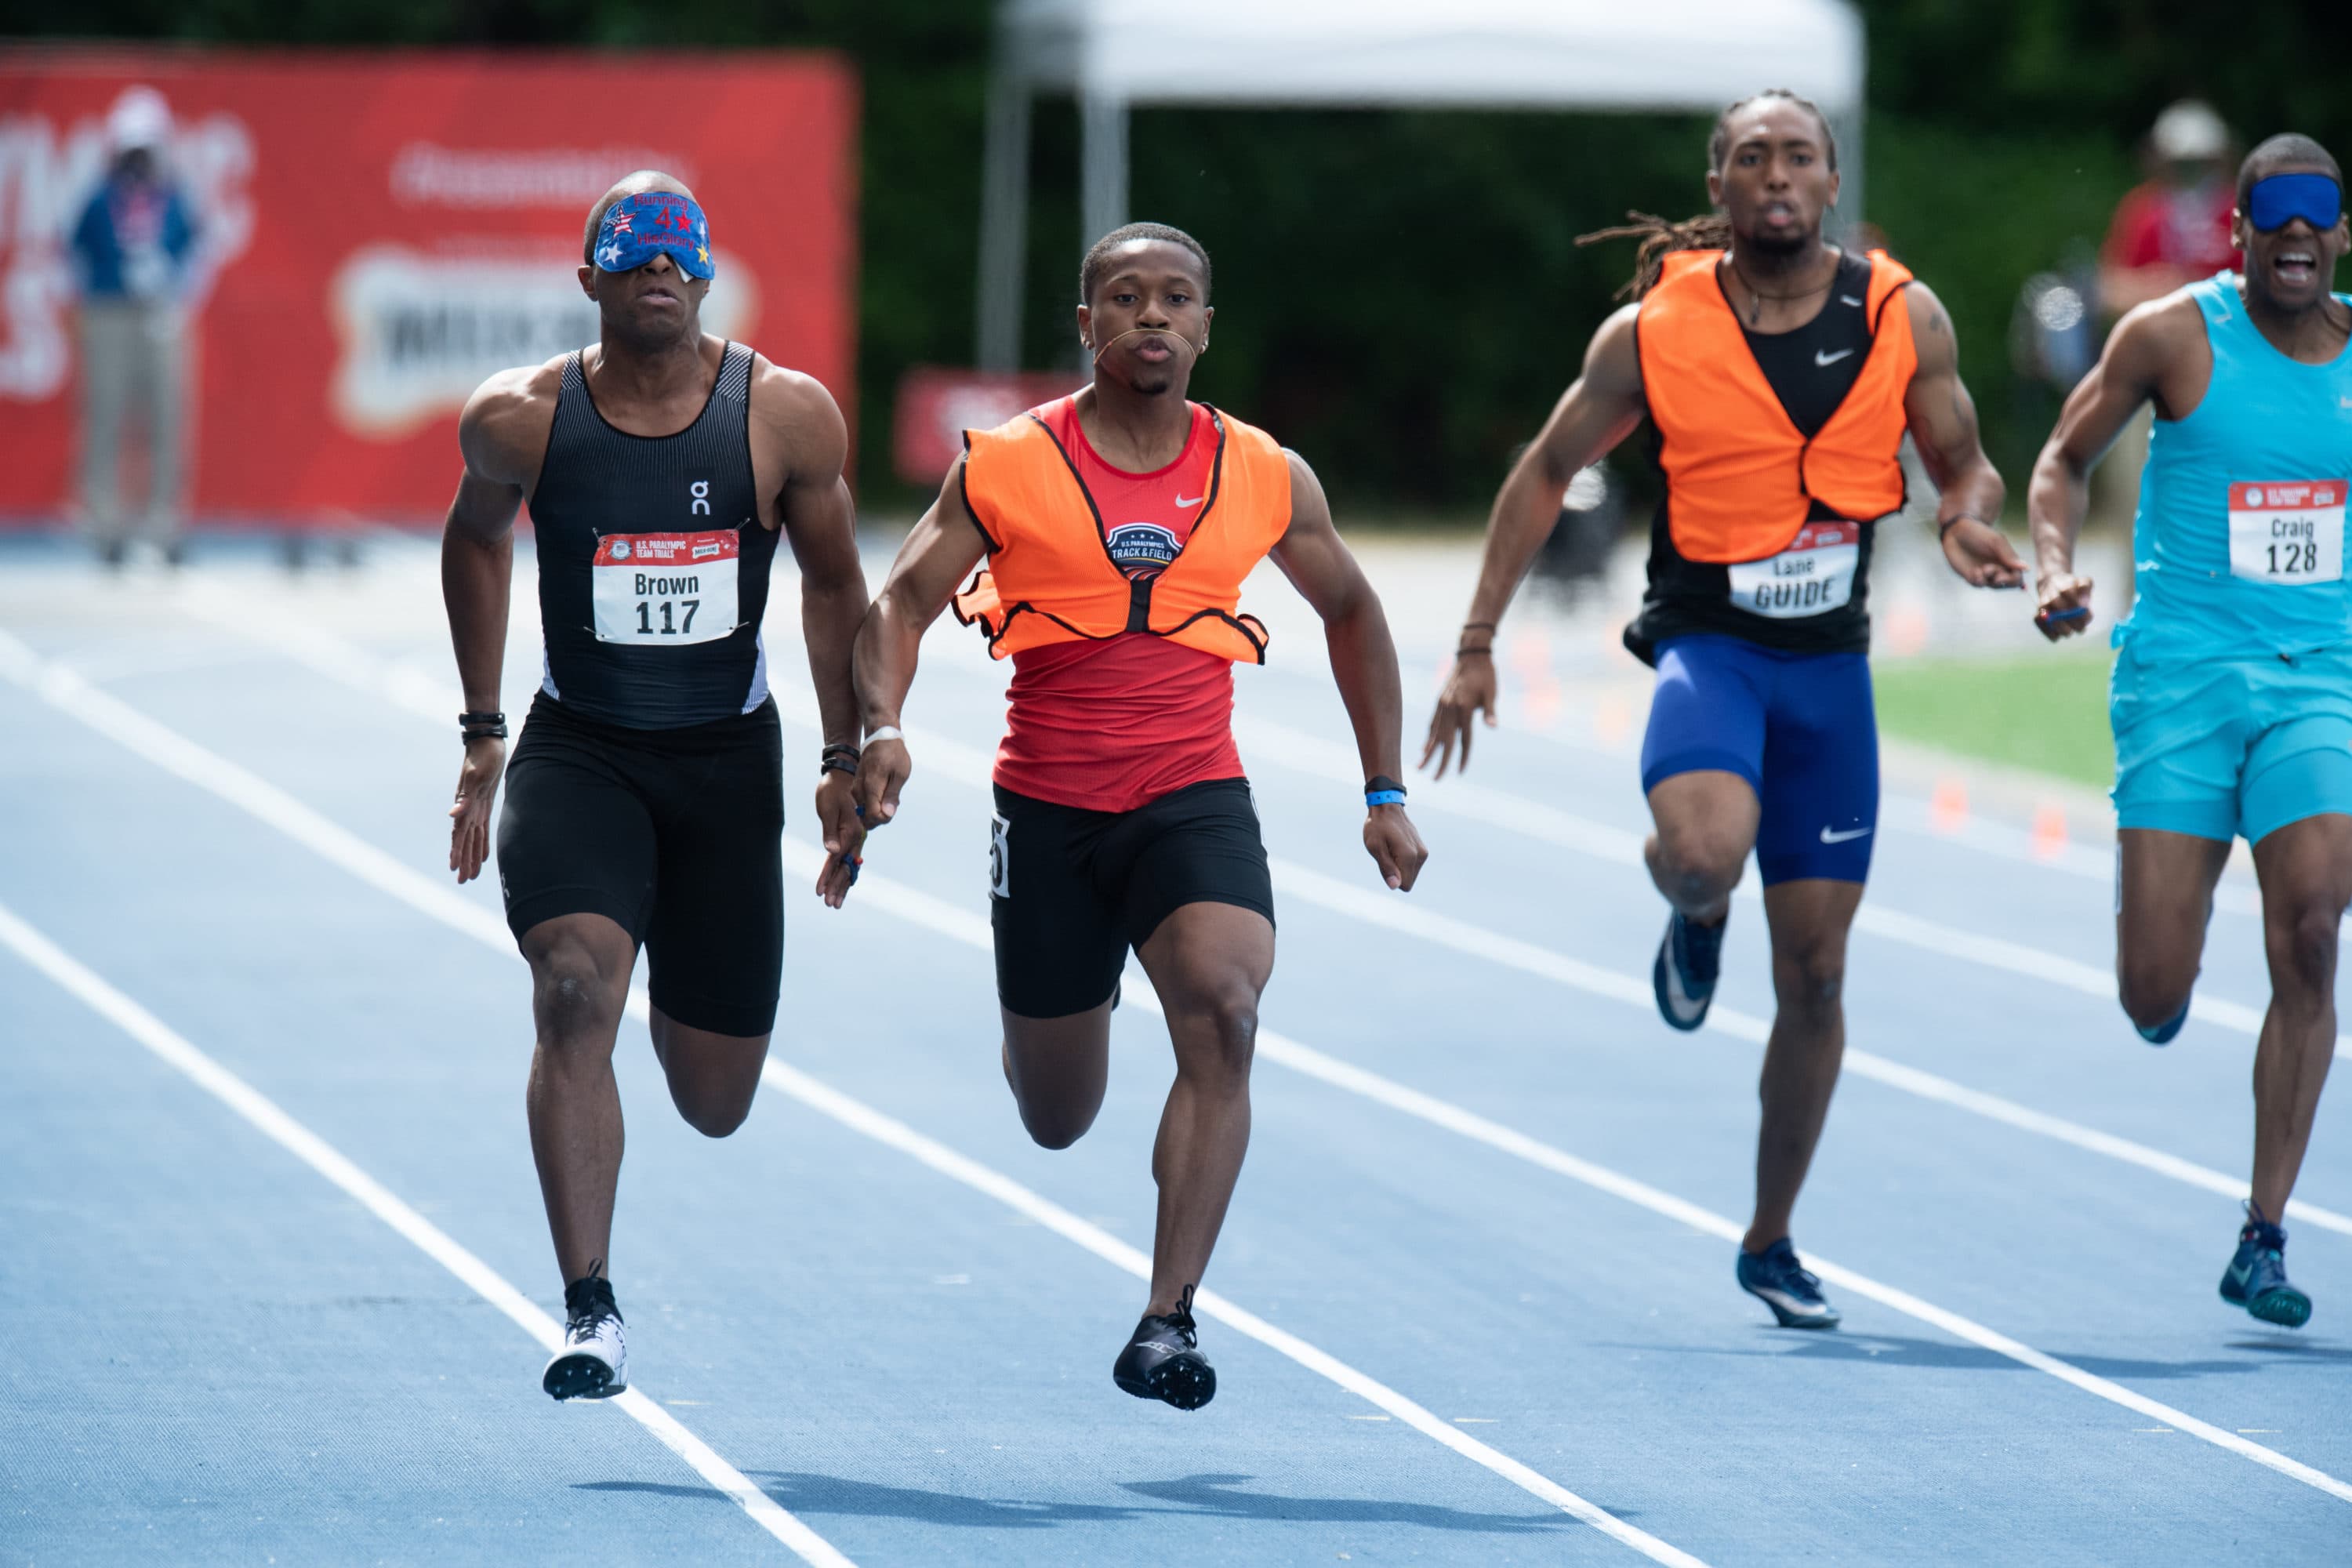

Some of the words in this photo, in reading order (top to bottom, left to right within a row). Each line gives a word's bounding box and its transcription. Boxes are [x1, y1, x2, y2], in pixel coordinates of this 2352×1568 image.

[634, 194, 689, 210] Running
[655, 207, 673, 229] 4
[2272, 516, 2314, 543] Craig
[636, 540, 648, 550] U.S.
[649, 539, 686, 550] PARALYMPIC
[637, 550, 653, 558] TEAM
[655, 550, 674, 559] TRIALS
[1112, 548, 1140, 559] TRACK
[1142, 548, 1148, 557] &
[1149, 550, 1172, 561] FIELD
[1131, 540, 1164, 549] PARALYMPICS
[1773, 557, 1815, 576] Lane
[2267, 543, 2318, 575] 128
[635, 572, 699, 596] Brown
[1755, 577, 1837, 609] GUIDE
[636, 599, 700, 635] 117
